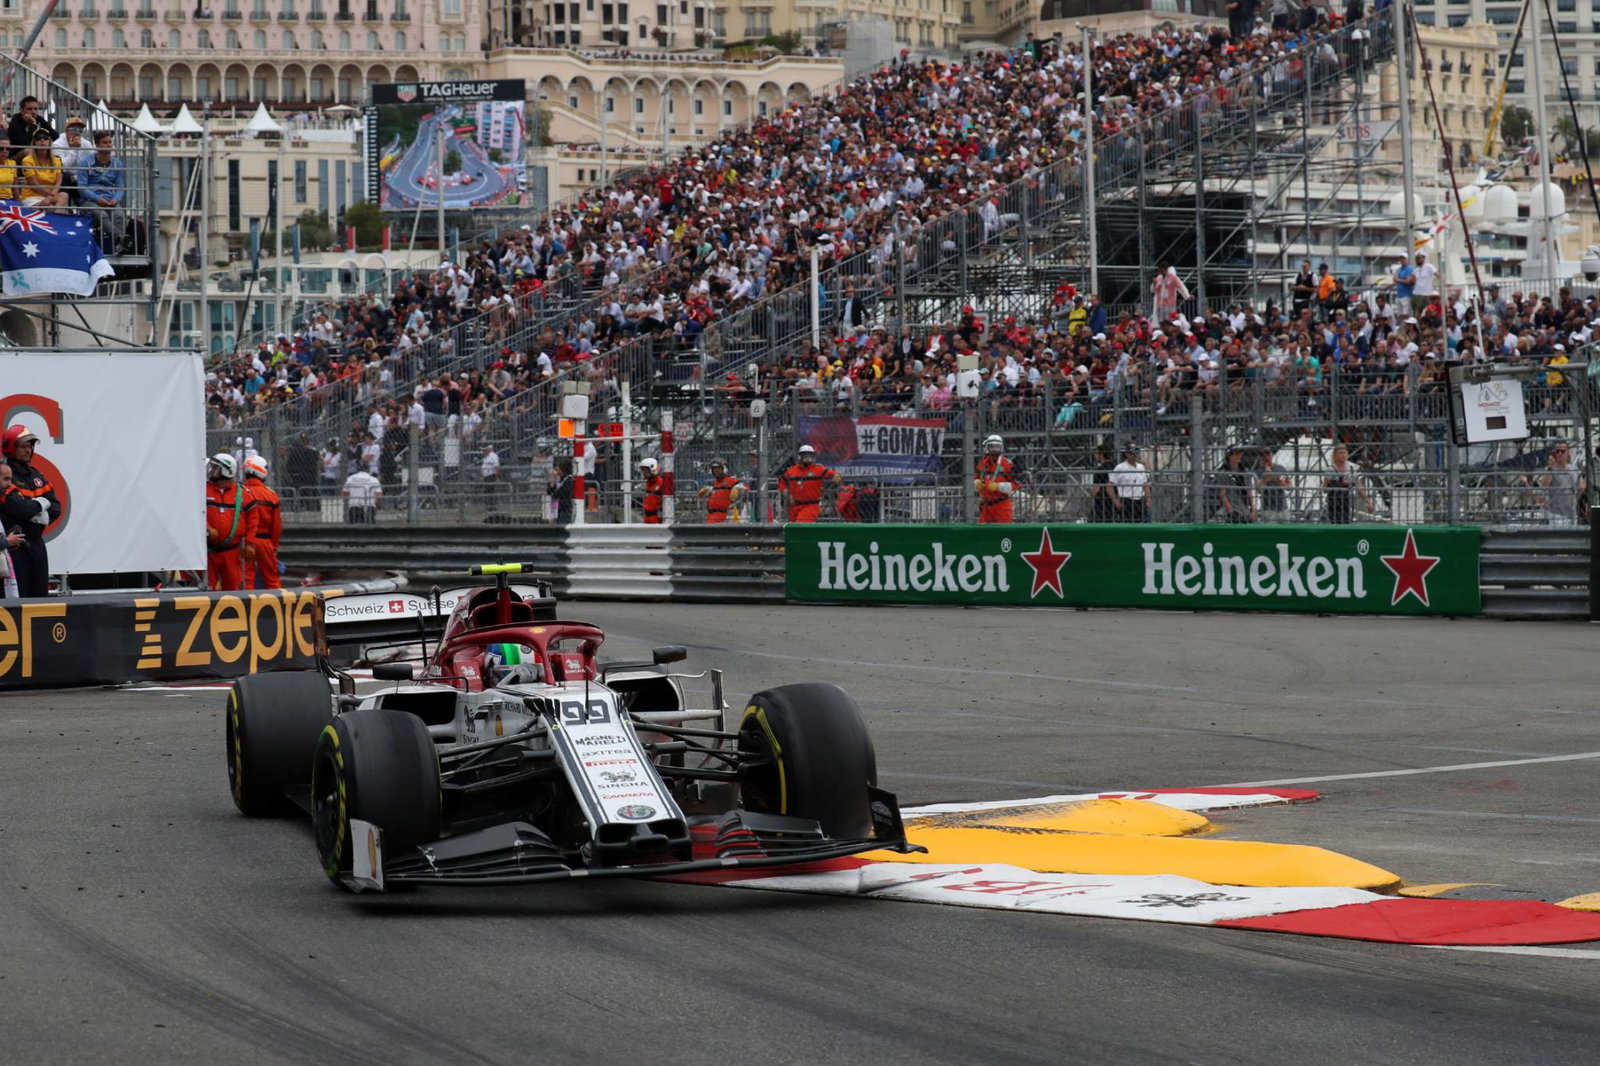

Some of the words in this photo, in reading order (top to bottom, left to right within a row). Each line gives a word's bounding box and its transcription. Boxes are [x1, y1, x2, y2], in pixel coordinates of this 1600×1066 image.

[862, 427, 941, 456] #GOMAX
[818, 541, 1009, 592] Heineken
[1142, 542, 1366, 598] Heineken
[327, 604, 384, 617] Schweiz
[561, 700, 611, 725] 99
[597, 781, 648, 789] SINGHA
